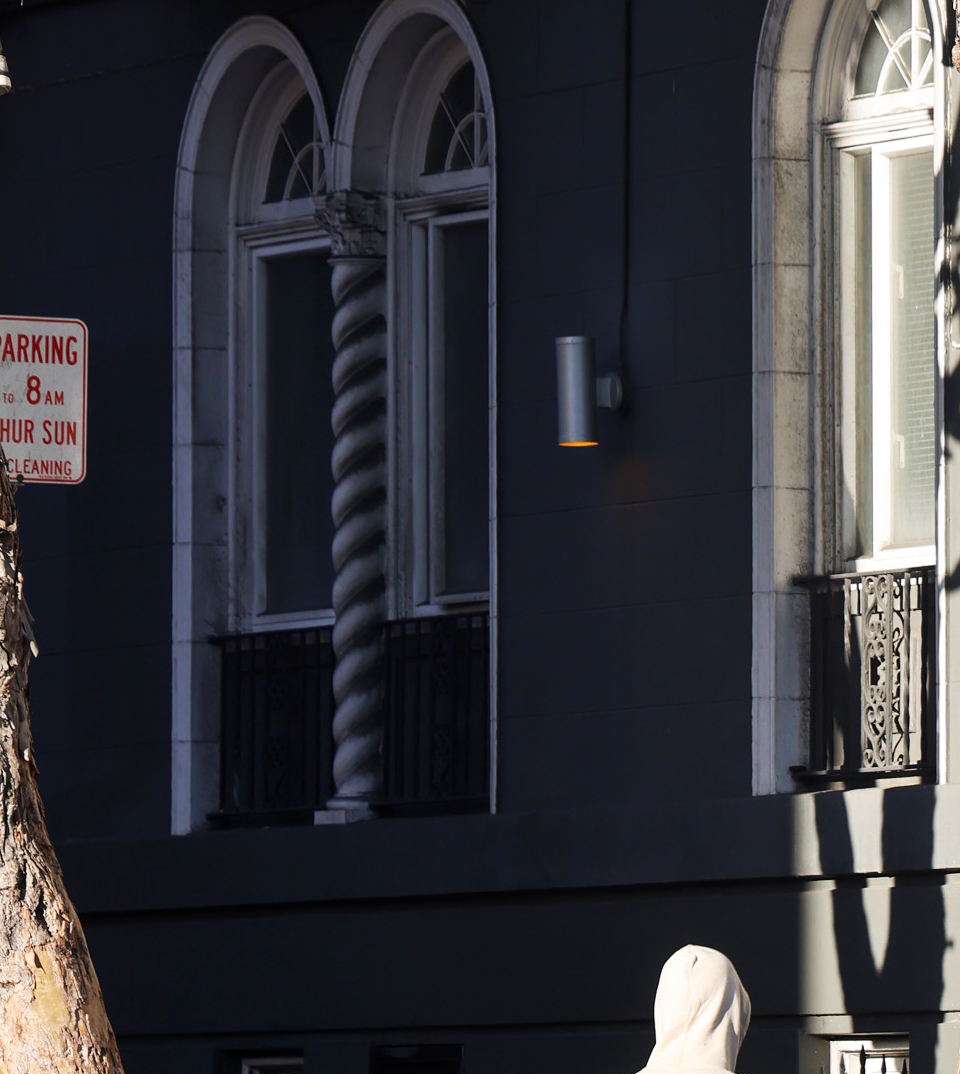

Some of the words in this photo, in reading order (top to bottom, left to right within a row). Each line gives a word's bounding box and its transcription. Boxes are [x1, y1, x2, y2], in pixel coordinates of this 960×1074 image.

[0, 333, 78, 366] ARKING
[3, 391, 14, 404] TO
[42, 419, 77, 446] SUN
[7, 458, 72, 476] CLEANING
